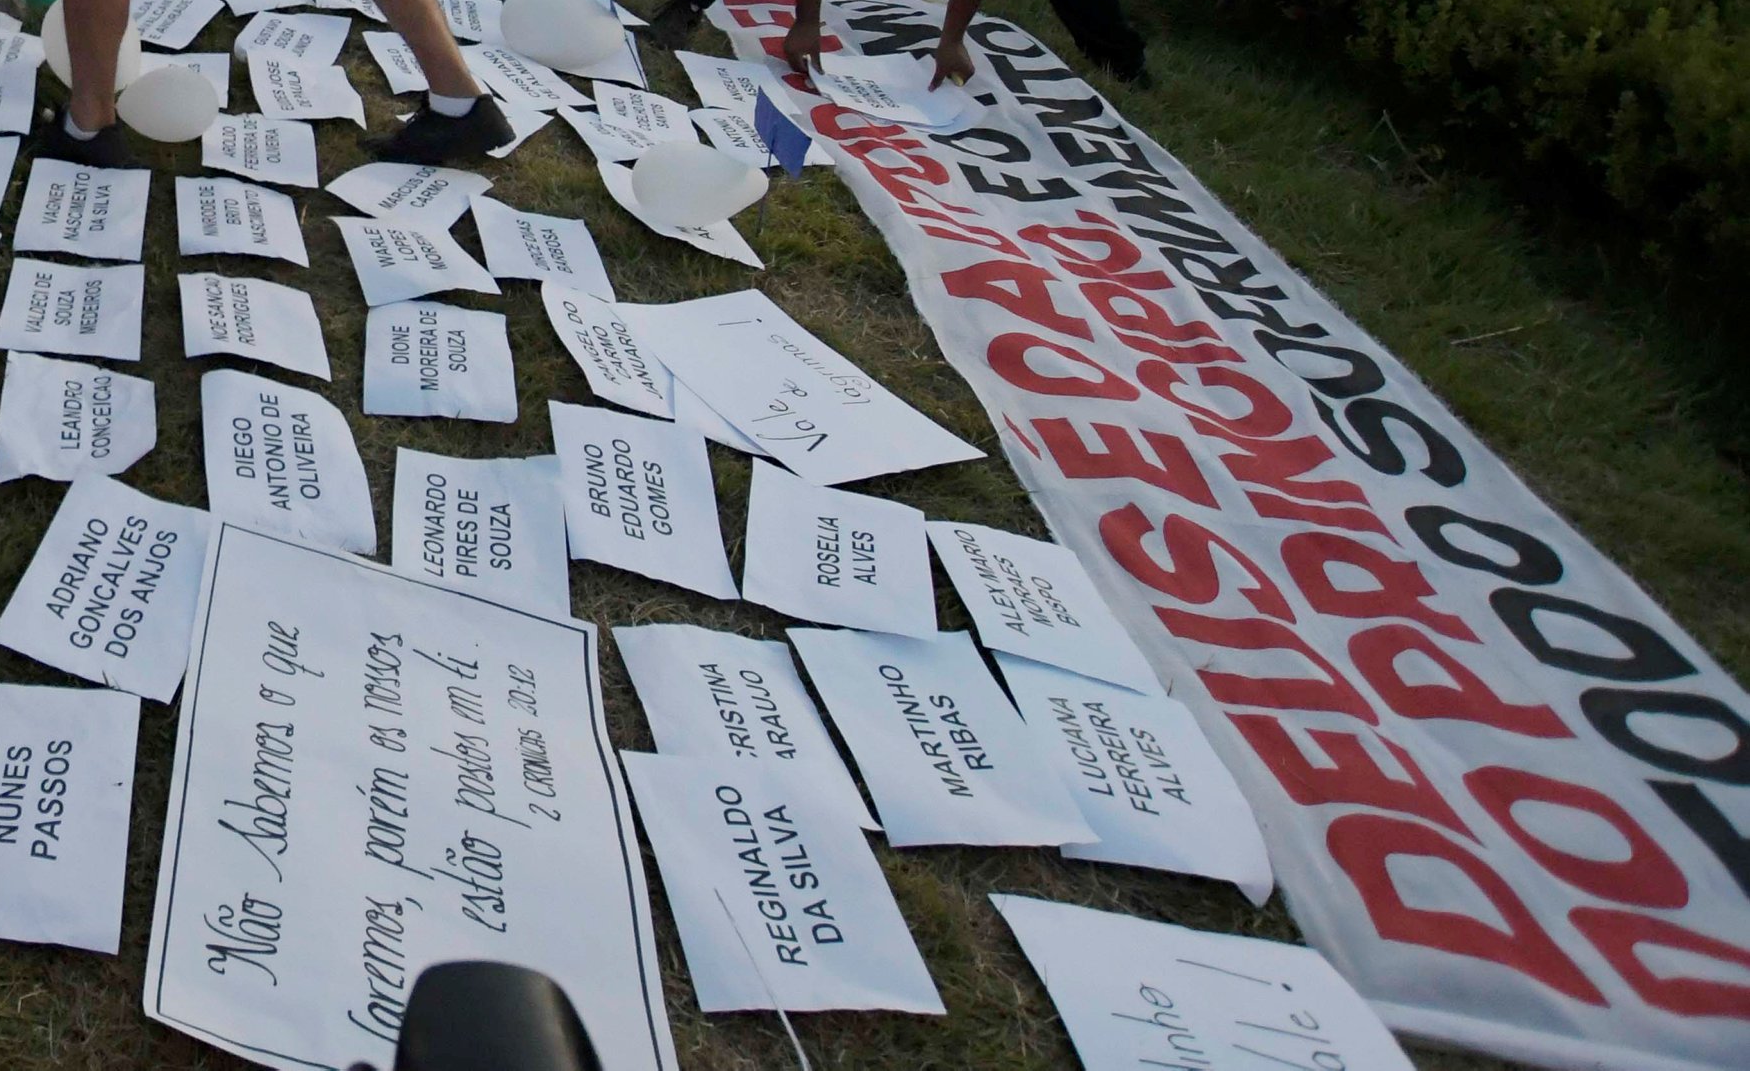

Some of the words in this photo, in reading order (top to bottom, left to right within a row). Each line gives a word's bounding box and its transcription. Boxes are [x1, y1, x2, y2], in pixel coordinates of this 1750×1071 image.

[482, 49, 542, 100] CRISTIANO
[539, 87, 561, 101] DE
[929, 128, 1031, 164] O
[41, 183, 66, 225] VAGNER
[63, 172, 91, 241] NASCIMENTO
[91, 183, 111, 214] SILVA
[224, 198, 243, 227] BRITO
[377, 172, 424, 212] MARCUS
[410, 178, 451, 210] CARMO
[958, 161, 1082, 202] E
[88, 212, 106, 233] DA
[389, 228, 419, 262] LOPES
[810, 103, 1095, 324] AUTOR
[36, 272, 53, 286] DE
[541, 228, 574, 275] BARBOSA
[967, 16, 1469, 490] SOFRIMENTO
[25, 286, 48, 333] VALDECI
[54, 289, 75, 327] SOUZA
[79, 279, 104, 335] MEDEIROS
[229, 282, 257, 347] RODRIGUES
[419, 309, 438, 328] DE
[562, 300, 585, 325] DO
[391, 324, 411, 365] DIONE
[419, 329, 440, 392] MOREIRA
[449, 328, 468, 374] SOUZA
[592, 325, 633, 383] CARMO
[609, 320, 664, 401] JANUARIO
[987, 331, 1142, 403] O
[60, 380, 83, 451] LEANDRO
[90, 375, 112, 459] CONCEICAO
[259, 391, 279, 417] DE
[782, 378, 810, 399] de
[232, 416, 256, 480] DIEGO
[293, 412, 322, 500] OLIVEIRA
[751, 397, 829, 453] Vale
[262, 421, 292, 511] ANTONIO
[583, 443, 612, 520] BRUNO
[612, 438, 646, 541] EDUARDO
[1002, 414, 1220, 511] É
[422, 473, 448, 578] LEONARDO
[457, 488, 479, 516] DE
[642, 460, 674, 536] GOMES
[455, 519, 479, 578] PIRES
[489, 501, 512, 571] SOUZA
[816, 515, 841, 589] ROSELIA
[851, 530, 878, 587] ALVES
[953, 528, 1005, 588] MARIO
[44, 517, 109, 620] ADRIANO
[68, 514, 149, 650] GONCALVES
[103, 607, 140, 661] DOS
[129, 529, 178, 605] ANJOS
[991, 556, 1056, 627] MORAES
[992, 585, 1030, 638] ALEX
[1032, 576, 1082, 629] BISPO
[261, 620, 324, 679] que
[363, 631, 404, 716] nossos
[443, 686, 485, 726] em
[877, 663, 974, 798] MARTINHO
[928, 693, 995, 773] RIBAS
[1404, 502, 1750, 901] TODO
[369, 723, 408, 754] os
[1047, 696, 1115, 797] LUCIANA
[1085, 700, 1161, 816] FERREIRA
[1099, 502, 1611, 1008] DEUS
[1129, 727, 1193, 806] ALVES
[29, 738, 73, 862] PASSOS
[429, 730, 534, 831] postos
[354, 773, 436, 882] porém
[527, 803, 561, 822] 2
[429, 828, 508, 934] estão
[715, 784, 808, 968] REGINALDO
[763, 804, 821, 895] SILVA
[808, 897, 845, 947] DA
